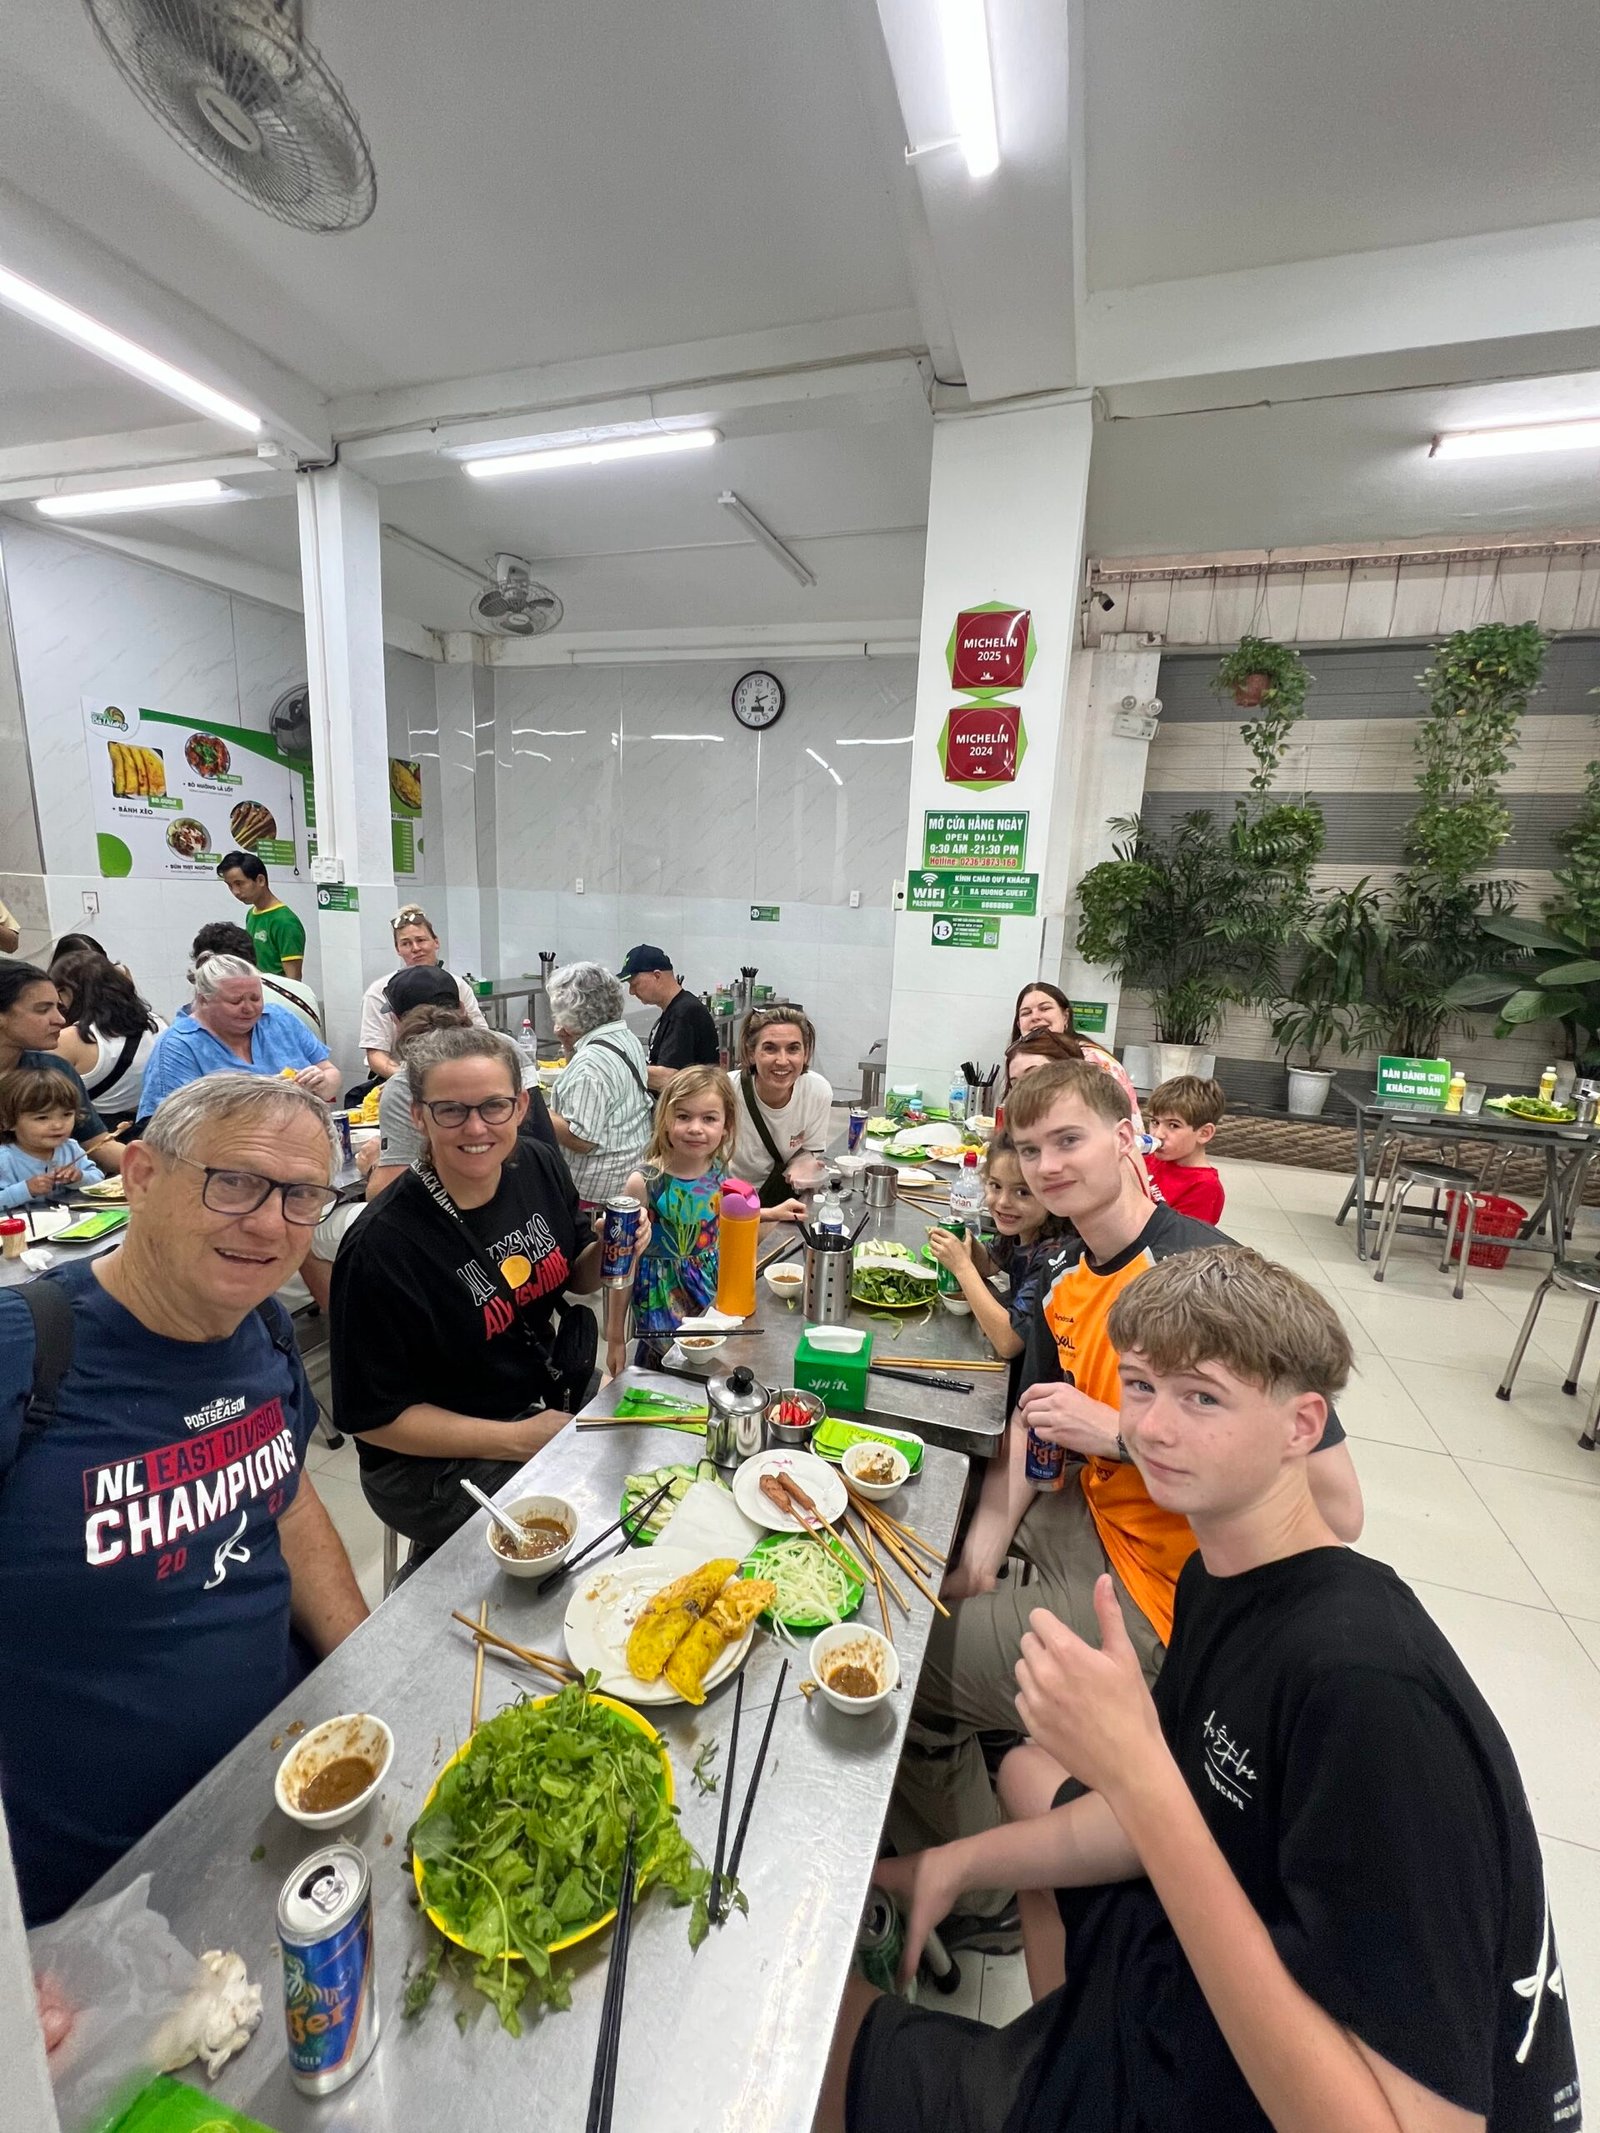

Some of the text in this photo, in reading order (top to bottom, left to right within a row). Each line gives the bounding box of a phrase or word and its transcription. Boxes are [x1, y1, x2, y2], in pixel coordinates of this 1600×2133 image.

[964, 637, 1018, 649] MICHELIN
[977, 651, 1002, 661] 2025
[956, 733, 1009, 744] MICHELIN
[969, 746, 993, 756] 2024
[928, 815, 944, 830] MỞ
[946, 815, 965, 830] CỬA
[997, 816, 1024, 831] NGÀY
[945, 833, 1004, 842] OPEN DAILY
[929, 844, 950, 854] 9:30
[952, 844, 968, 854] AM
[1003, 845, 1019, 855] PM
[913, 888, 945, 899] WIFI
[936, 925, 950, 936] 13
[1428, 1073, 1446, 1083] CHO
[184, 1395, 246, 1430] POSTSEASON
[95, 1404, 283, 1506] NL EAST DIVISION
[85, 1429, 297, 1567] CHAMPIONS
[157, 1488, 284, 1581] 20 21
